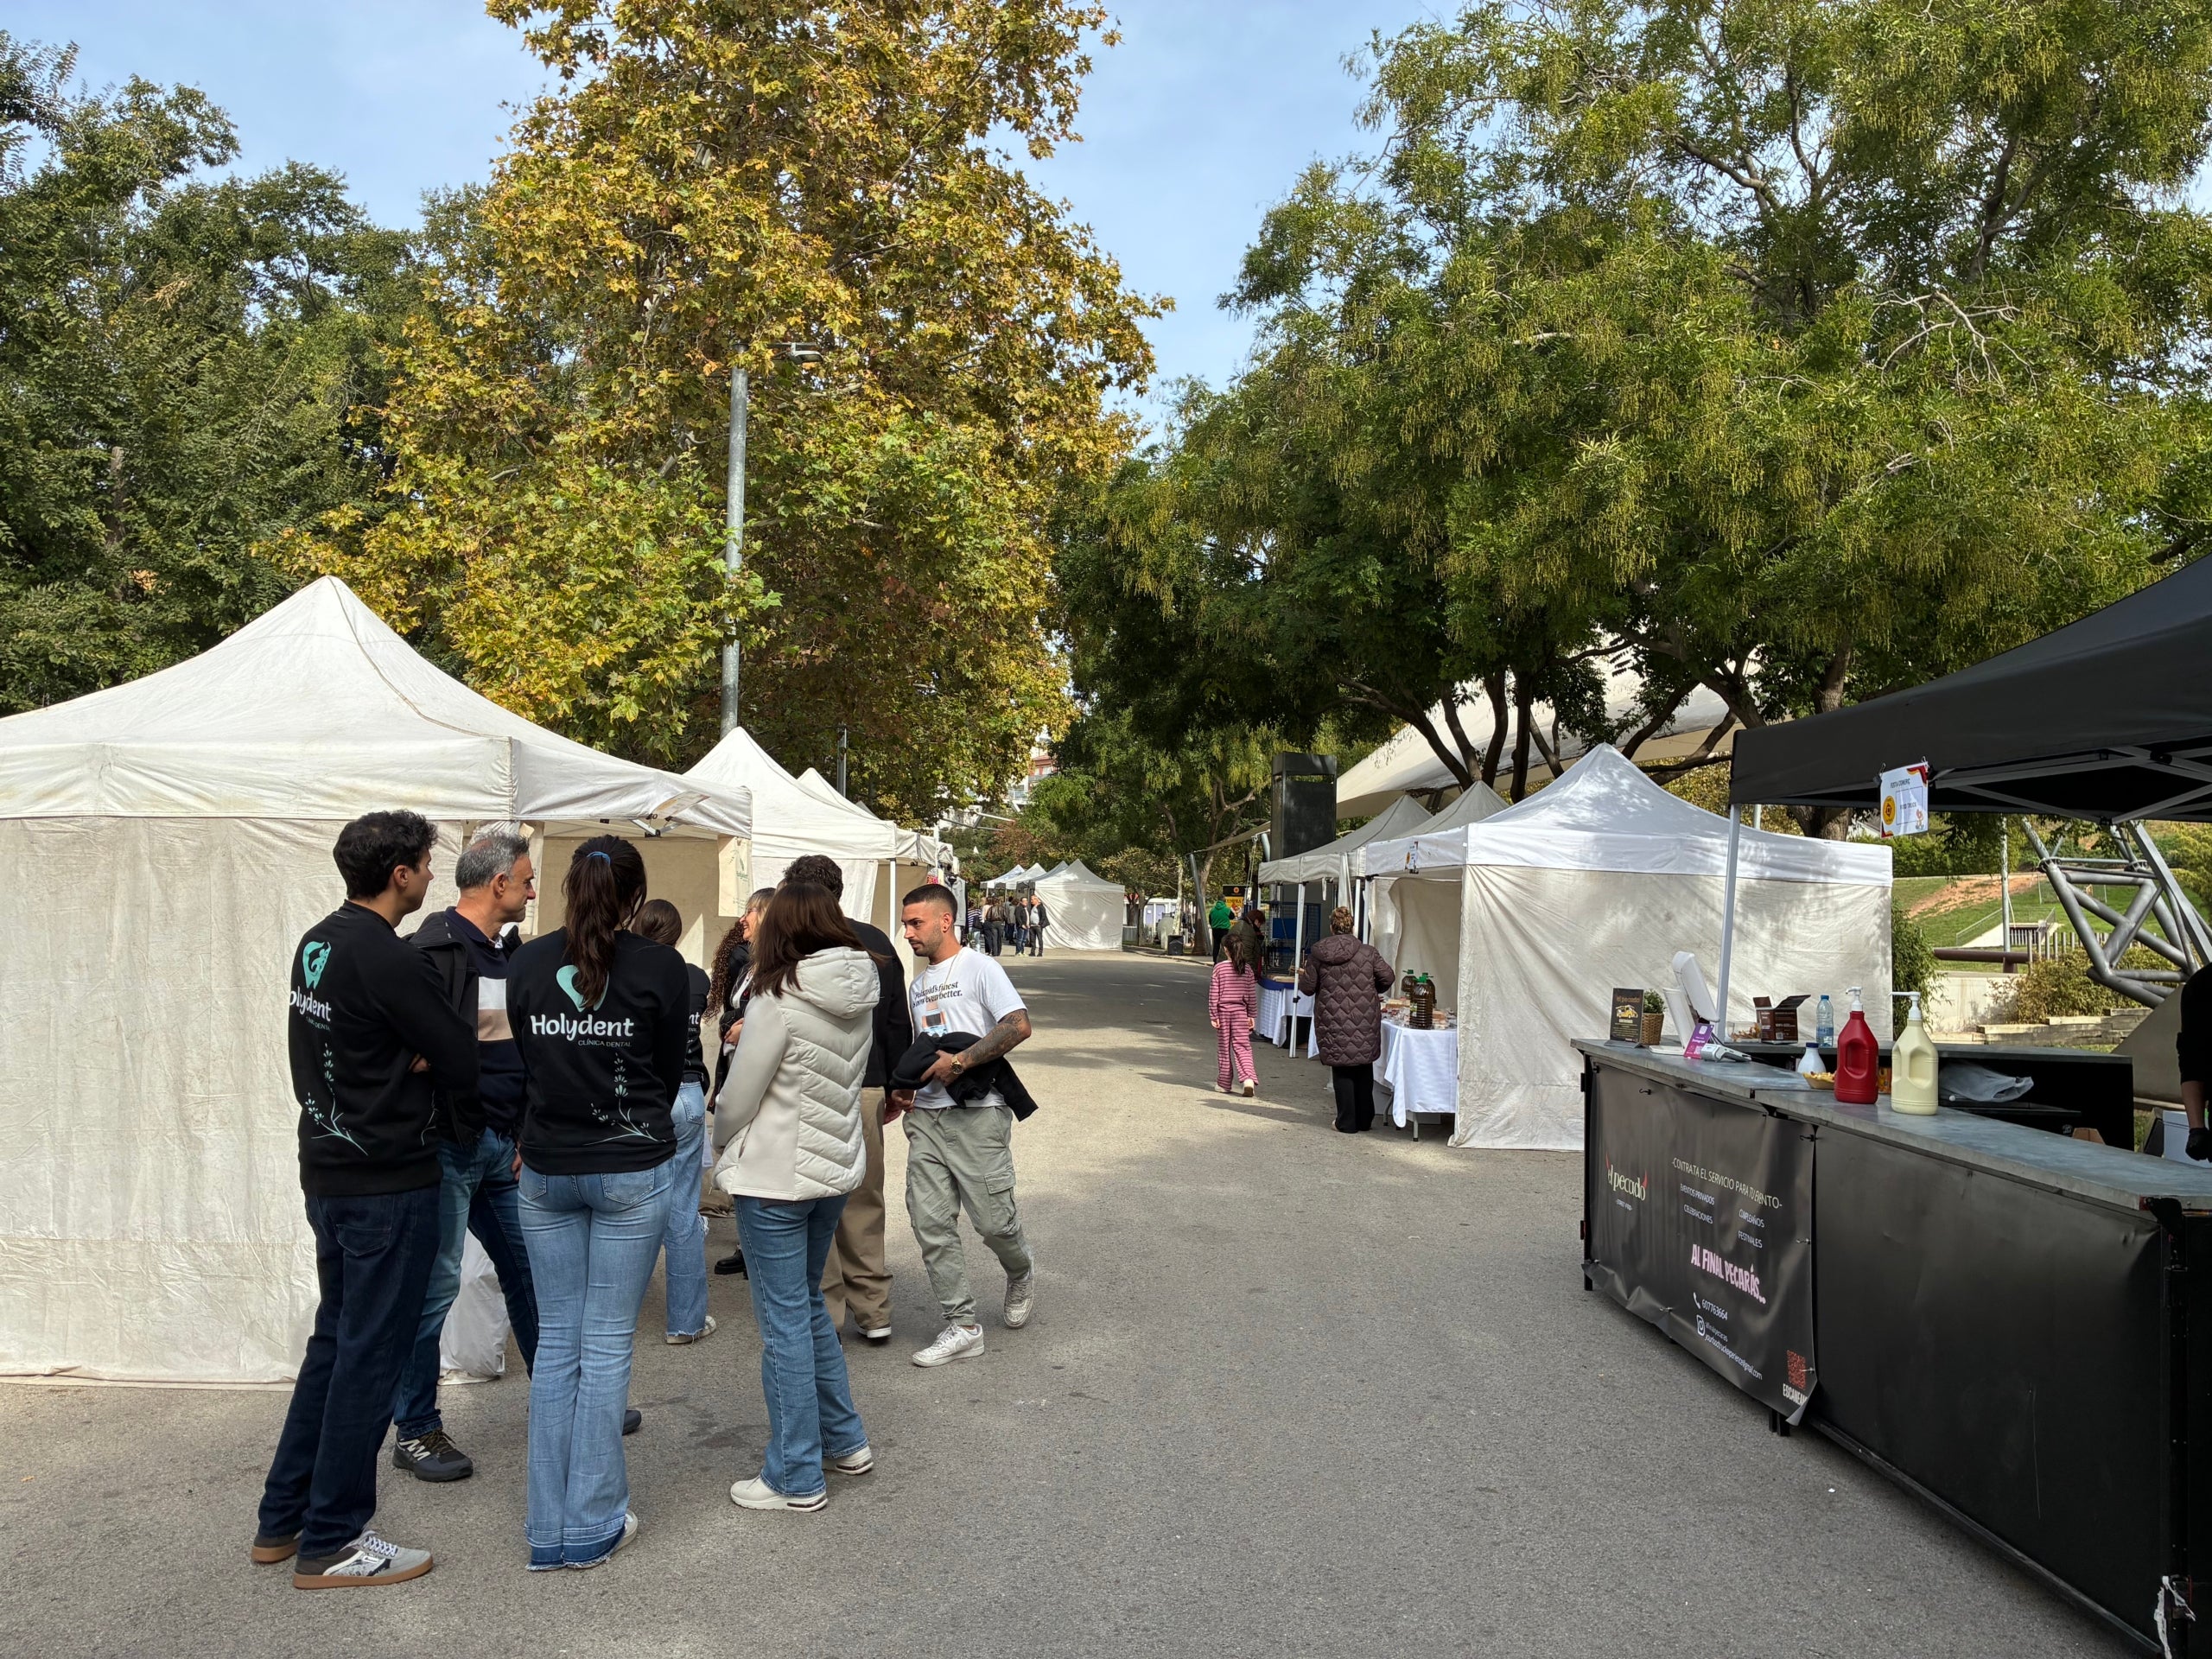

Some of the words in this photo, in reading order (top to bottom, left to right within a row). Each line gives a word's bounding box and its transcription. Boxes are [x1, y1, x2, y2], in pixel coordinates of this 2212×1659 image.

[289, 985, 332, 1021] olydent
[938, 989, 963, 1000] better.
[530, 1012, 635, 1041] Holydent
[577, 1038, 605, 1046] CLÍNICA
[1700, 1167, 1707, 1180] EL
[1707, 1171, 1735, 1190] SERVICIO
[1735, 1180, 1749, 1195] PARA
[1738, 1230, 1763, 1249] FESTIVALES
[1690, 1243, 1701, 1267] AL
[1701, 1249, 1725, 1279] FINAL
